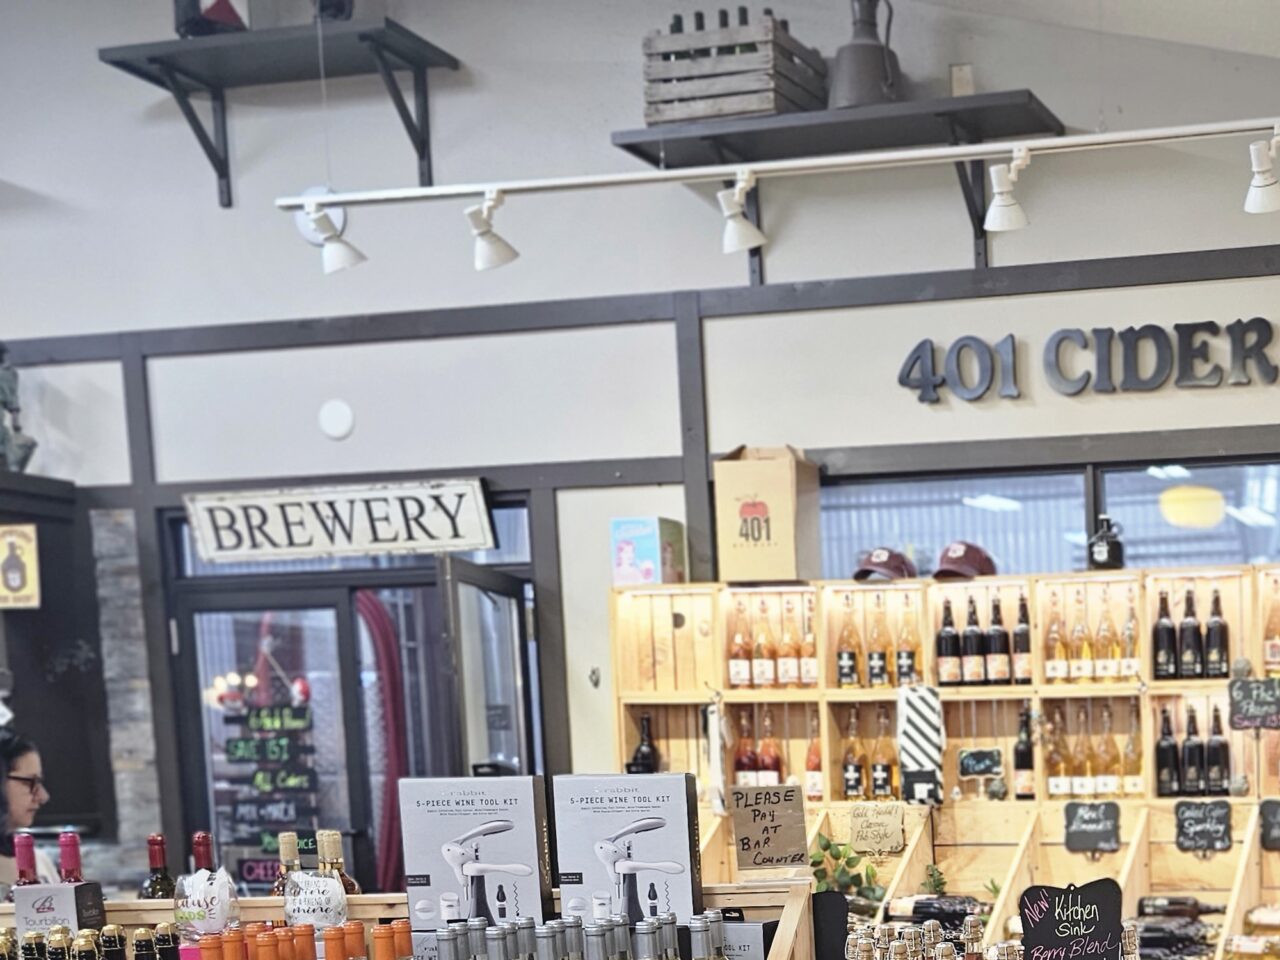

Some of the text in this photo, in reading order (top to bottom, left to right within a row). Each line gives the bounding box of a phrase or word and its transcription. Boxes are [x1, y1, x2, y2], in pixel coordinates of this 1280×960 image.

[897, 332, 1021, 404] 401
[1043, 316, 1280, 397] CIDER
[203, 492, 468, 553] BREWERY
[738, 516, 771, 542] 401
[416, 799, 451, 808] 5-PIECE
[455, 799, 476, 807] WINE
[570, 797, 604, 805] 5-PIECE
[608, 796, 628, 804] WINE
[733, 789, 796, 808] PLEASE
[762, 824, 782, 835] AT
[740, 836, 771, 851] BAR
[753, 851, 805, 866] COUNTER
[1054, 893, 1100, 922] Kitchen
[1055, 922, 1096, 938] Sink
[1069, 932, 1119, 960] Blend
